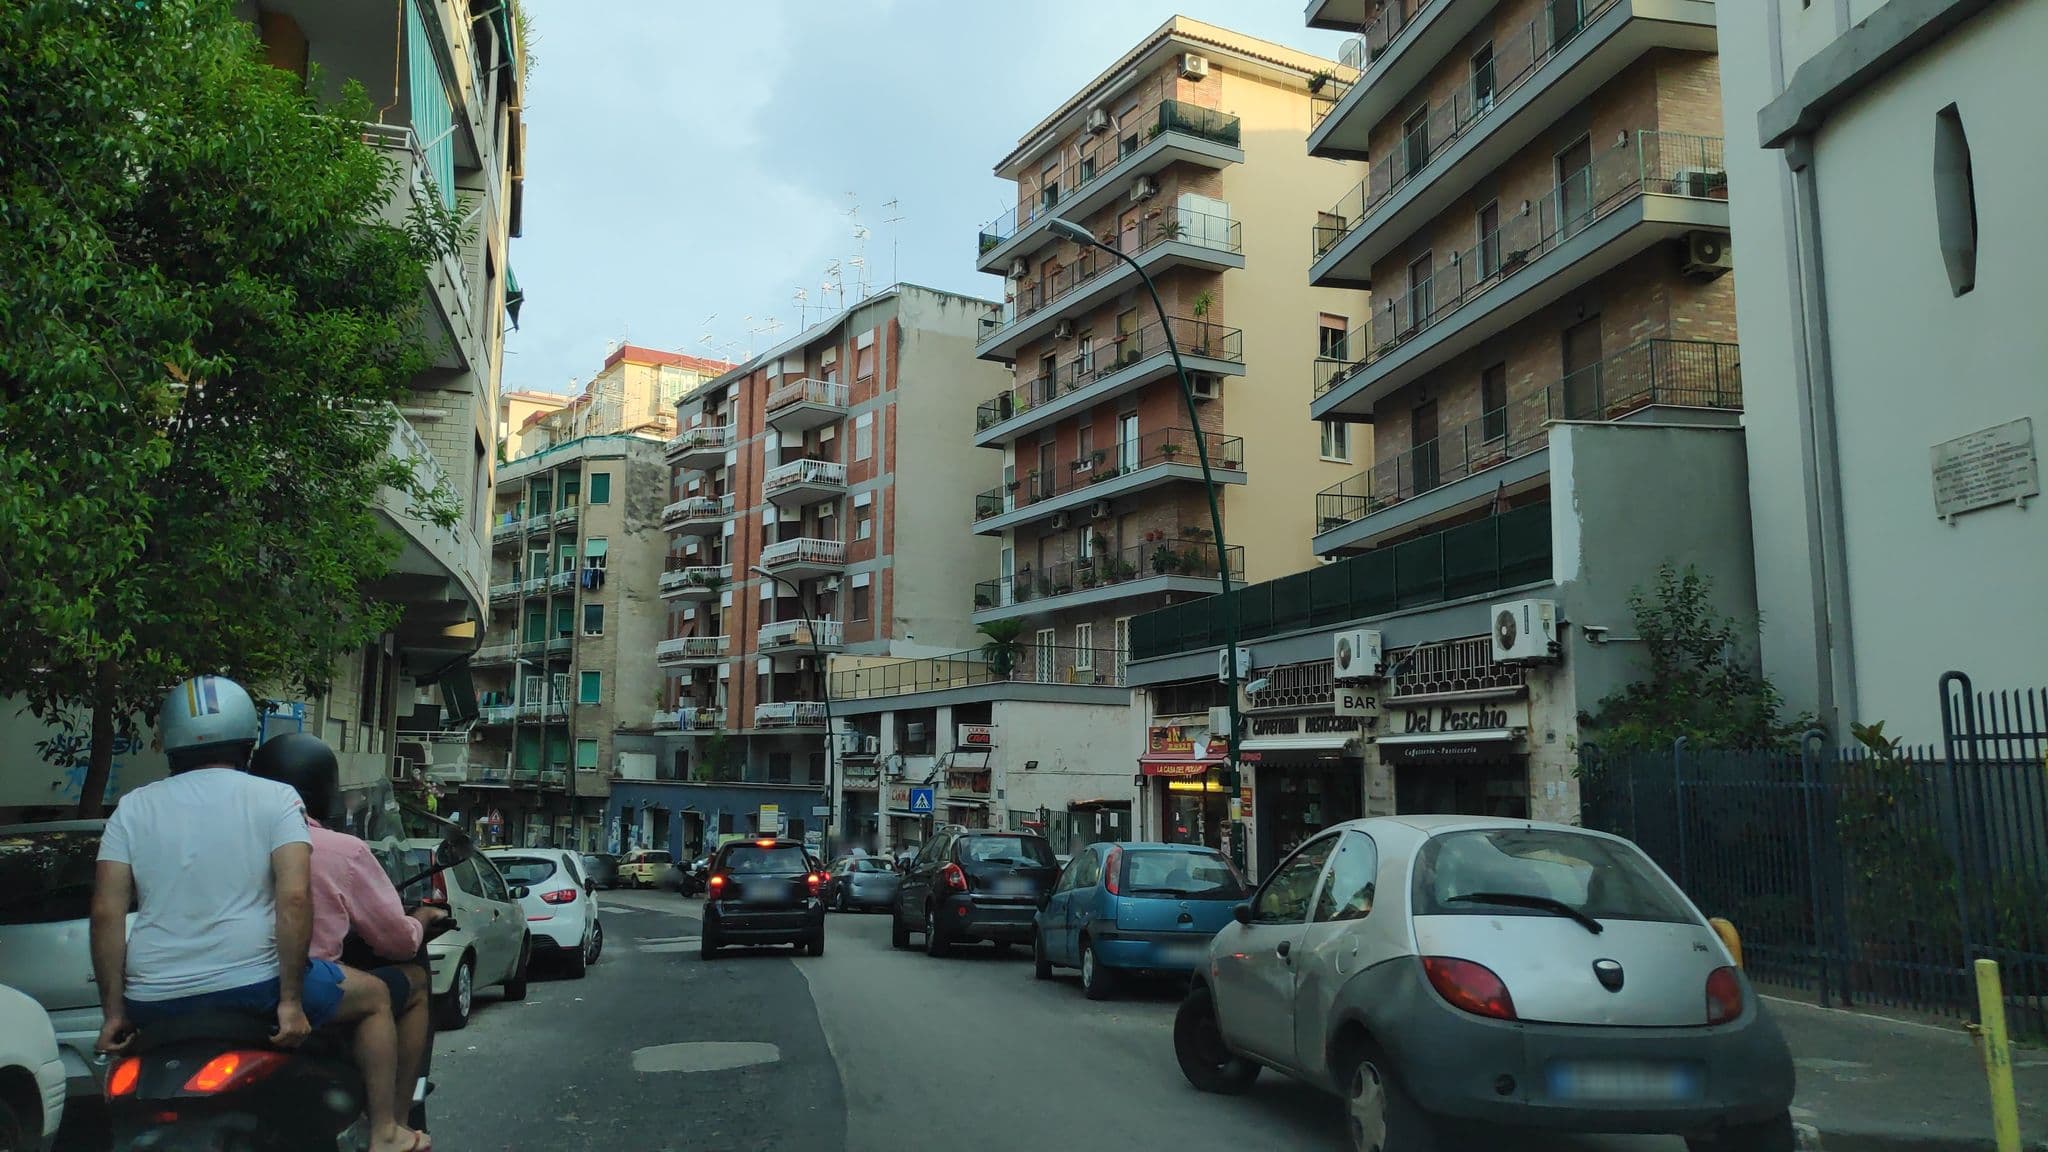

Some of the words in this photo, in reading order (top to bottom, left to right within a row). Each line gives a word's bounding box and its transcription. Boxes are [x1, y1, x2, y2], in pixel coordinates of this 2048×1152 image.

[1343, 695, 1376, 710] BAR
[1404, 706, 1433, 733] Del
[1440, 703, 1508, 732] Peschio
